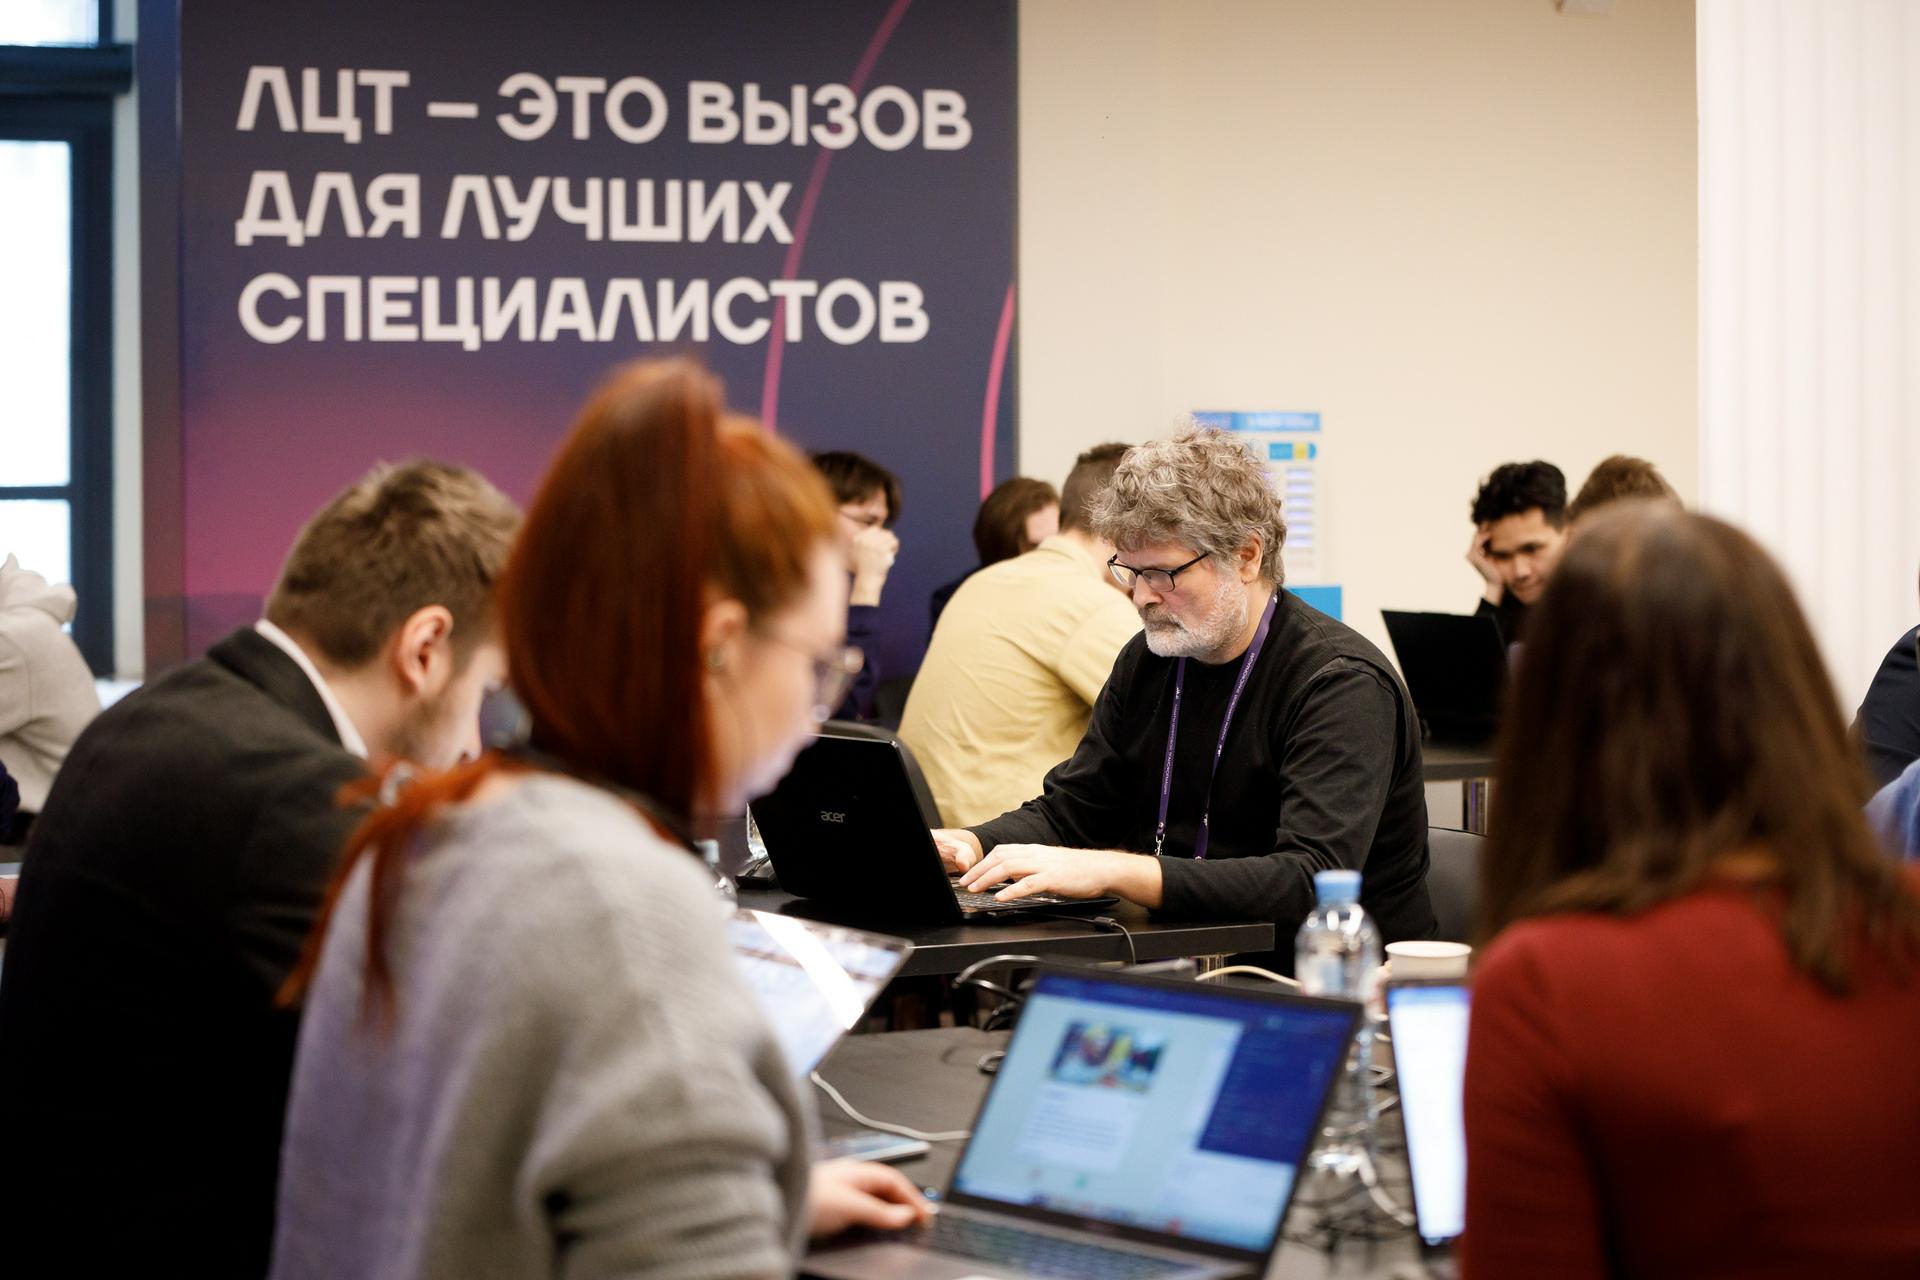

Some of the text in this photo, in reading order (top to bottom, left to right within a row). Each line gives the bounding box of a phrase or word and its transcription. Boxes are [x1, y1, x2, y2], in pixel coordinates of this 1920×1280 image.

[236, 66, 410, 143] ЛЦТ
[497, 72, 668, 143] ЭТО
[688, 80, 973, 151] ВЫЗОВ
[235, 170, 795, 247] ДЛЯ ЛУЧШИХ
[237, 272, 931, 352] СПЕЦИАЛИСТОВ
[820, 810, 846, 823] acer
